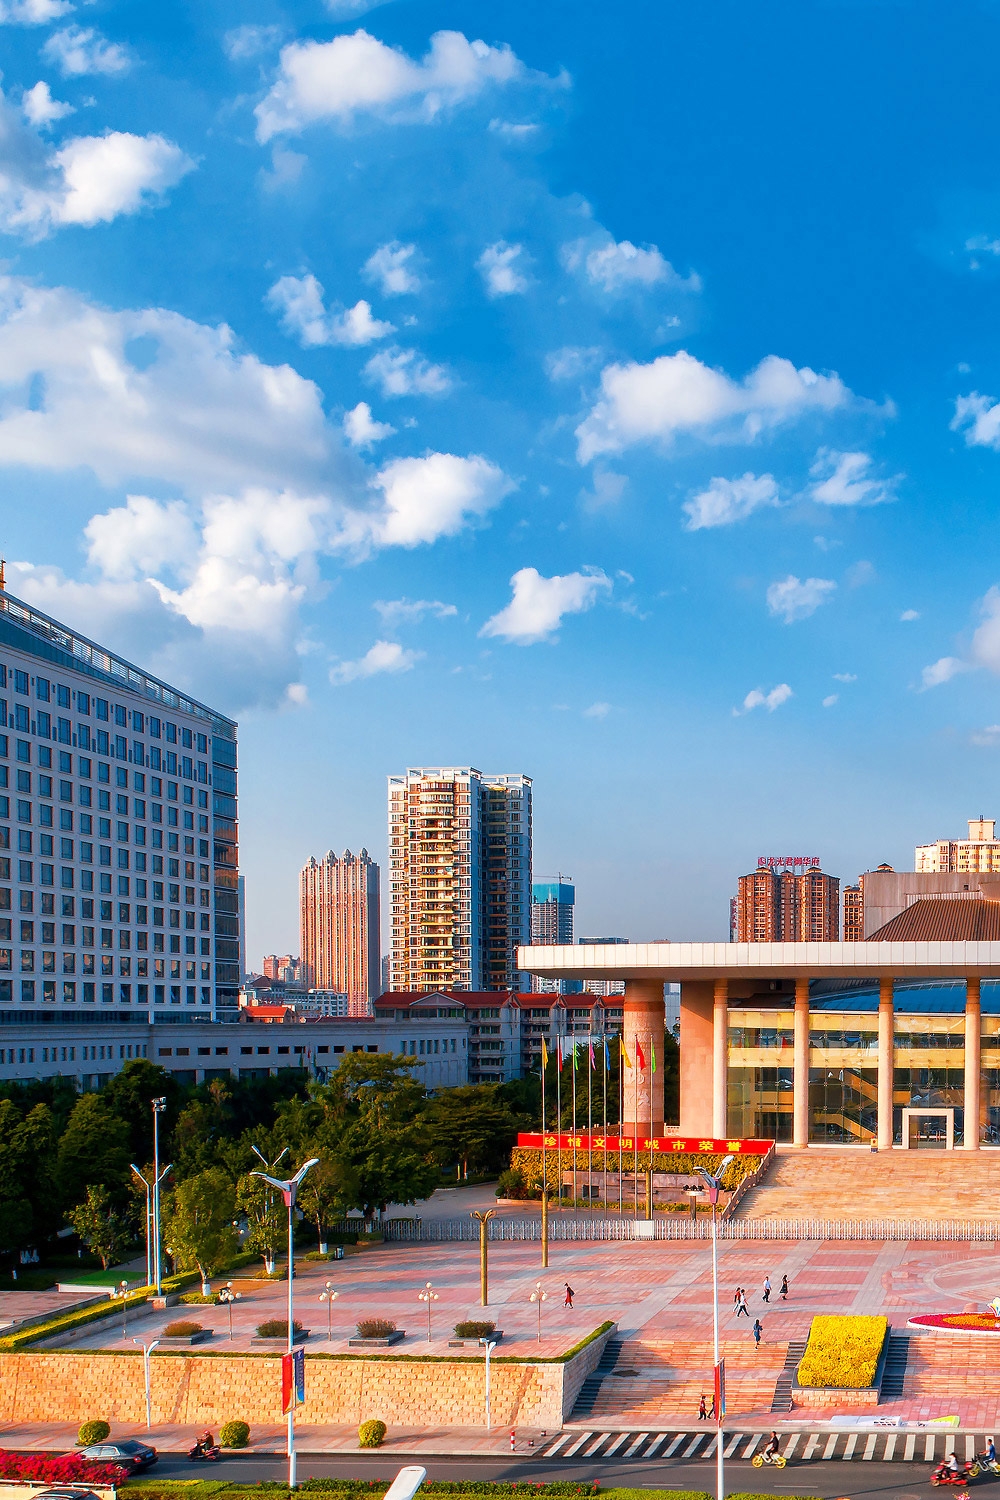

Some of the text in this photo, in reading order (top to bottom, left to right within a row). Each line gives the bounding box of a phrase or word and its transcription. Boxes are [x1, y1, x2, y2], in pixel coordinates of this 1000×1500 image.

[543, 1137, 742, 1152] 珍惜文明城市荣誉
